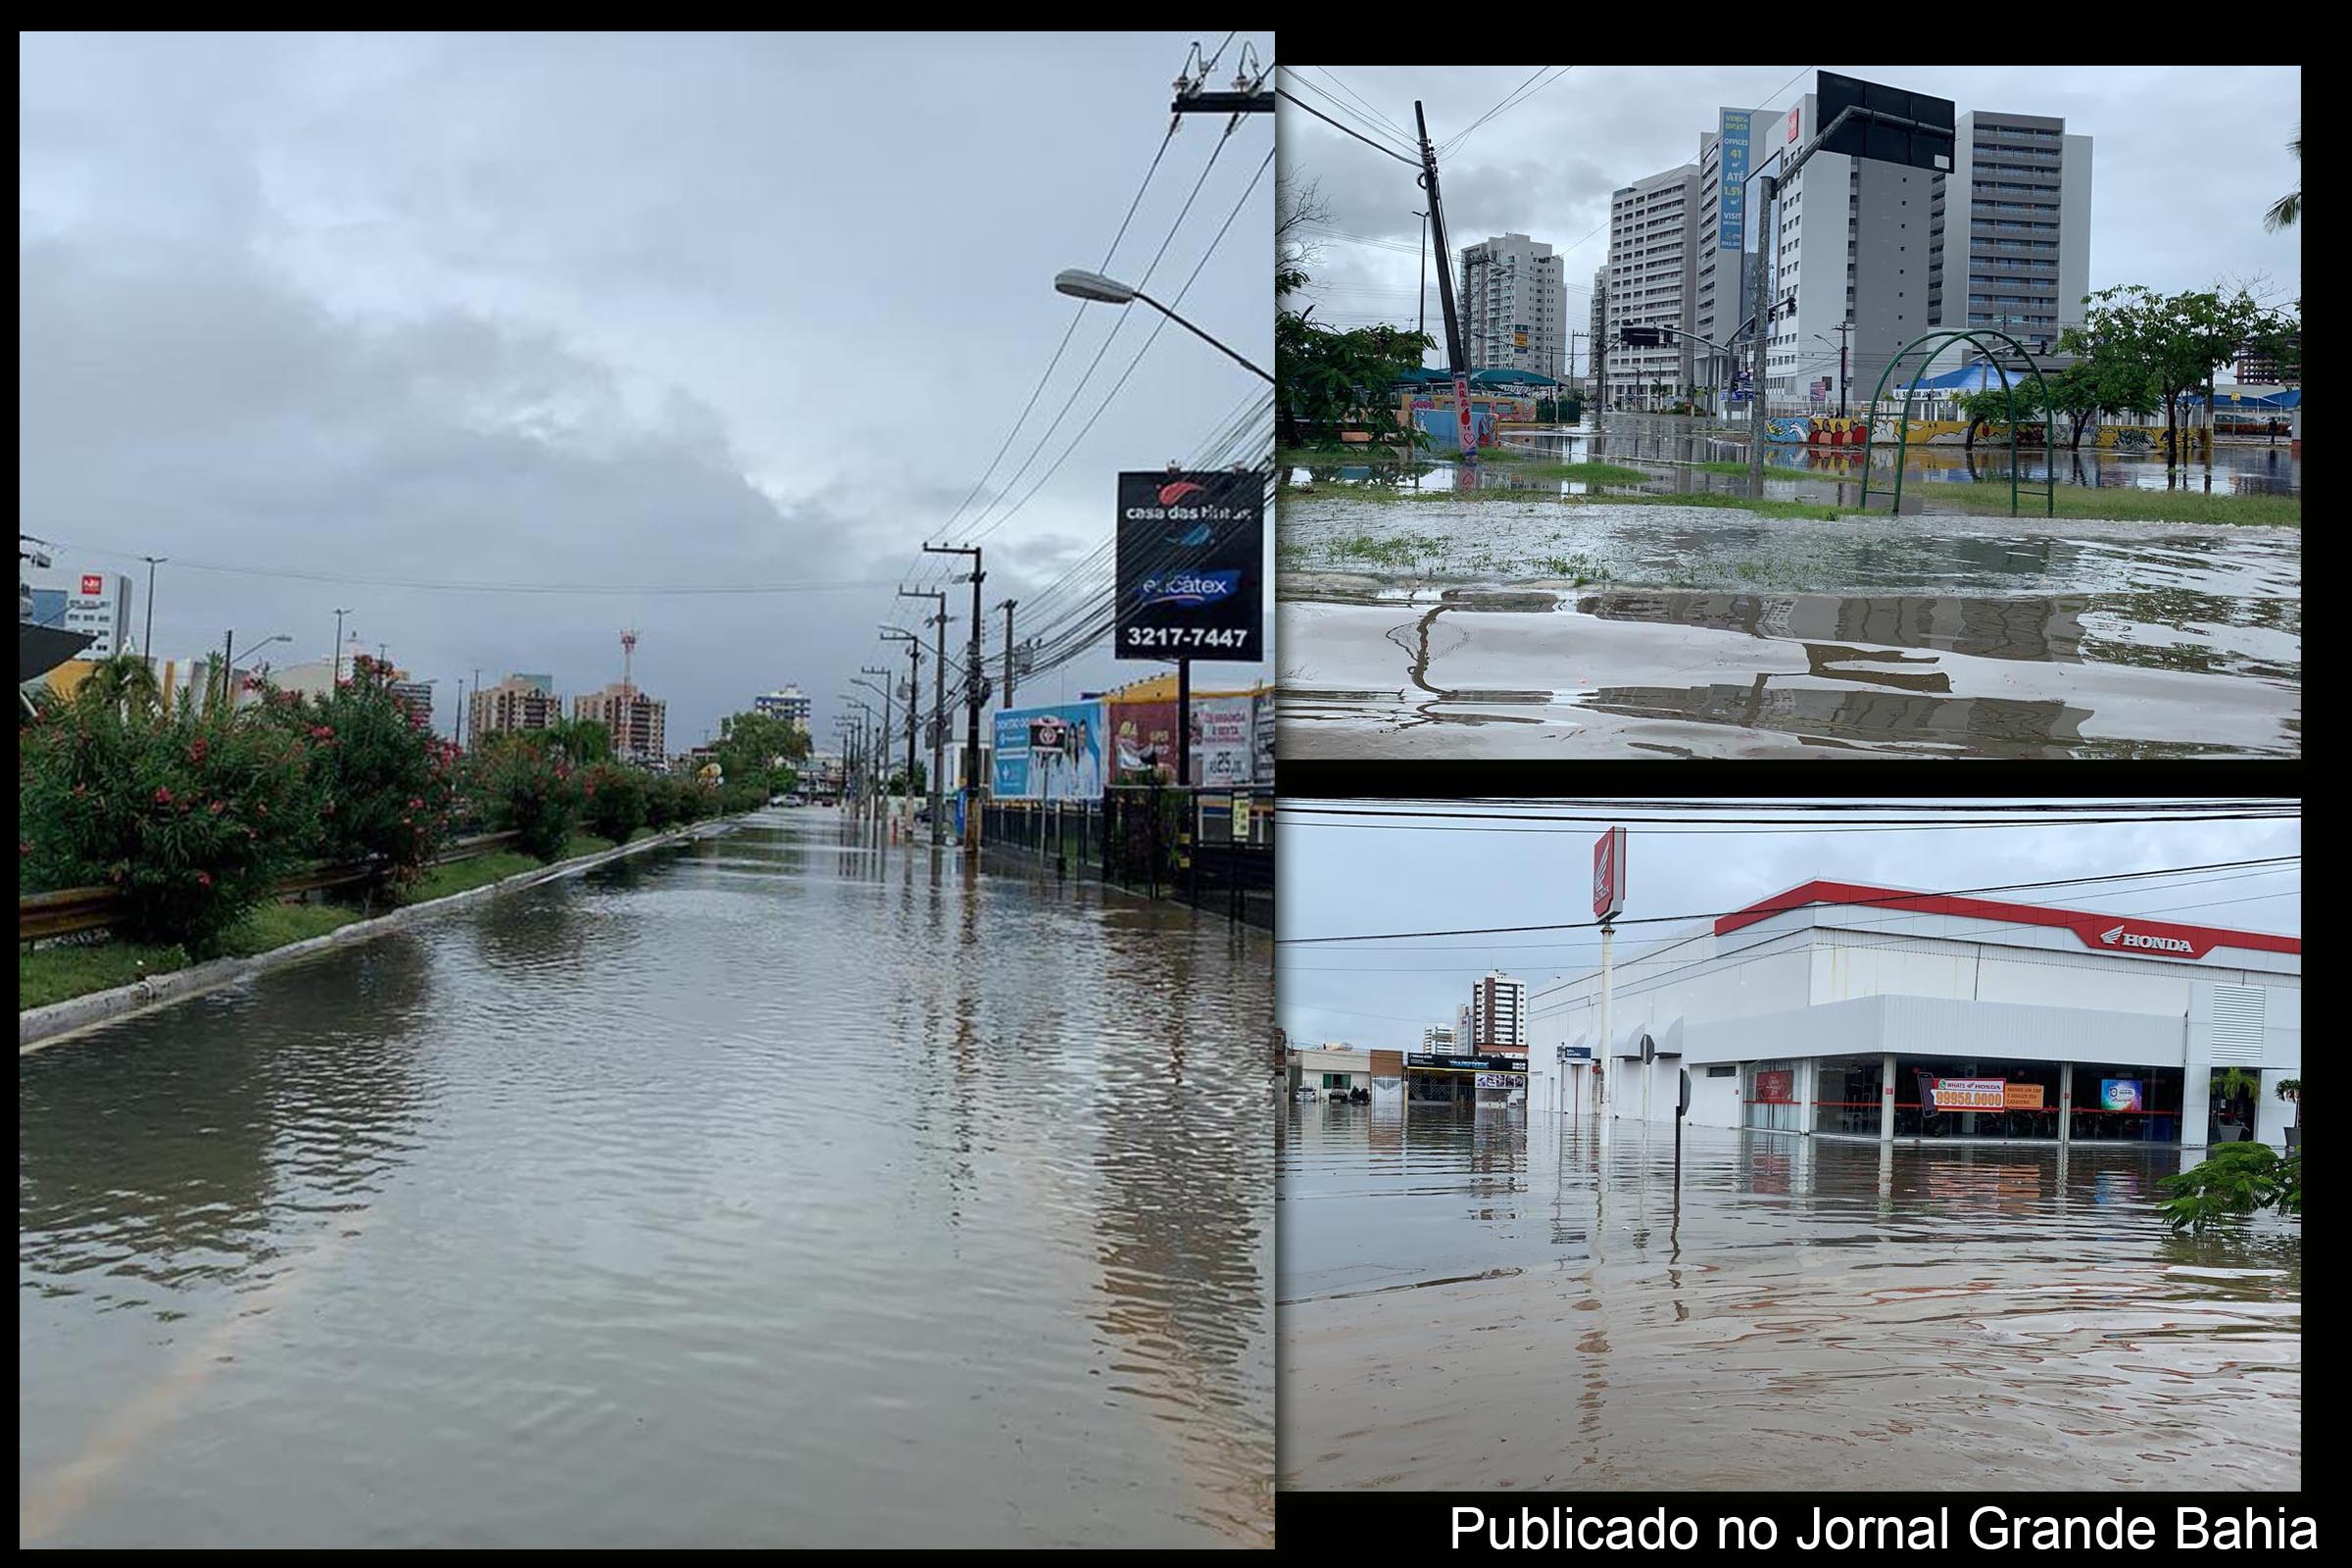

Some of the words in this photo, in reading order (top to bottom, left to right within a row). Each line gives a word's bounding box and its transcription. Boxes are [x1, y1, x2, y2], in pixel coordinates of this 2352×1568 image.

[1731, 149, 1740, 158] 41
[1126, 507, 1165, 519] casa
[1168, 506, 1199, 519] das
[1128, 627, 1248, 647] 3217-7447
[2122, 934, 2194, 953] HONDA
[1936, 1091, 2002, 1106] 99958.0000
